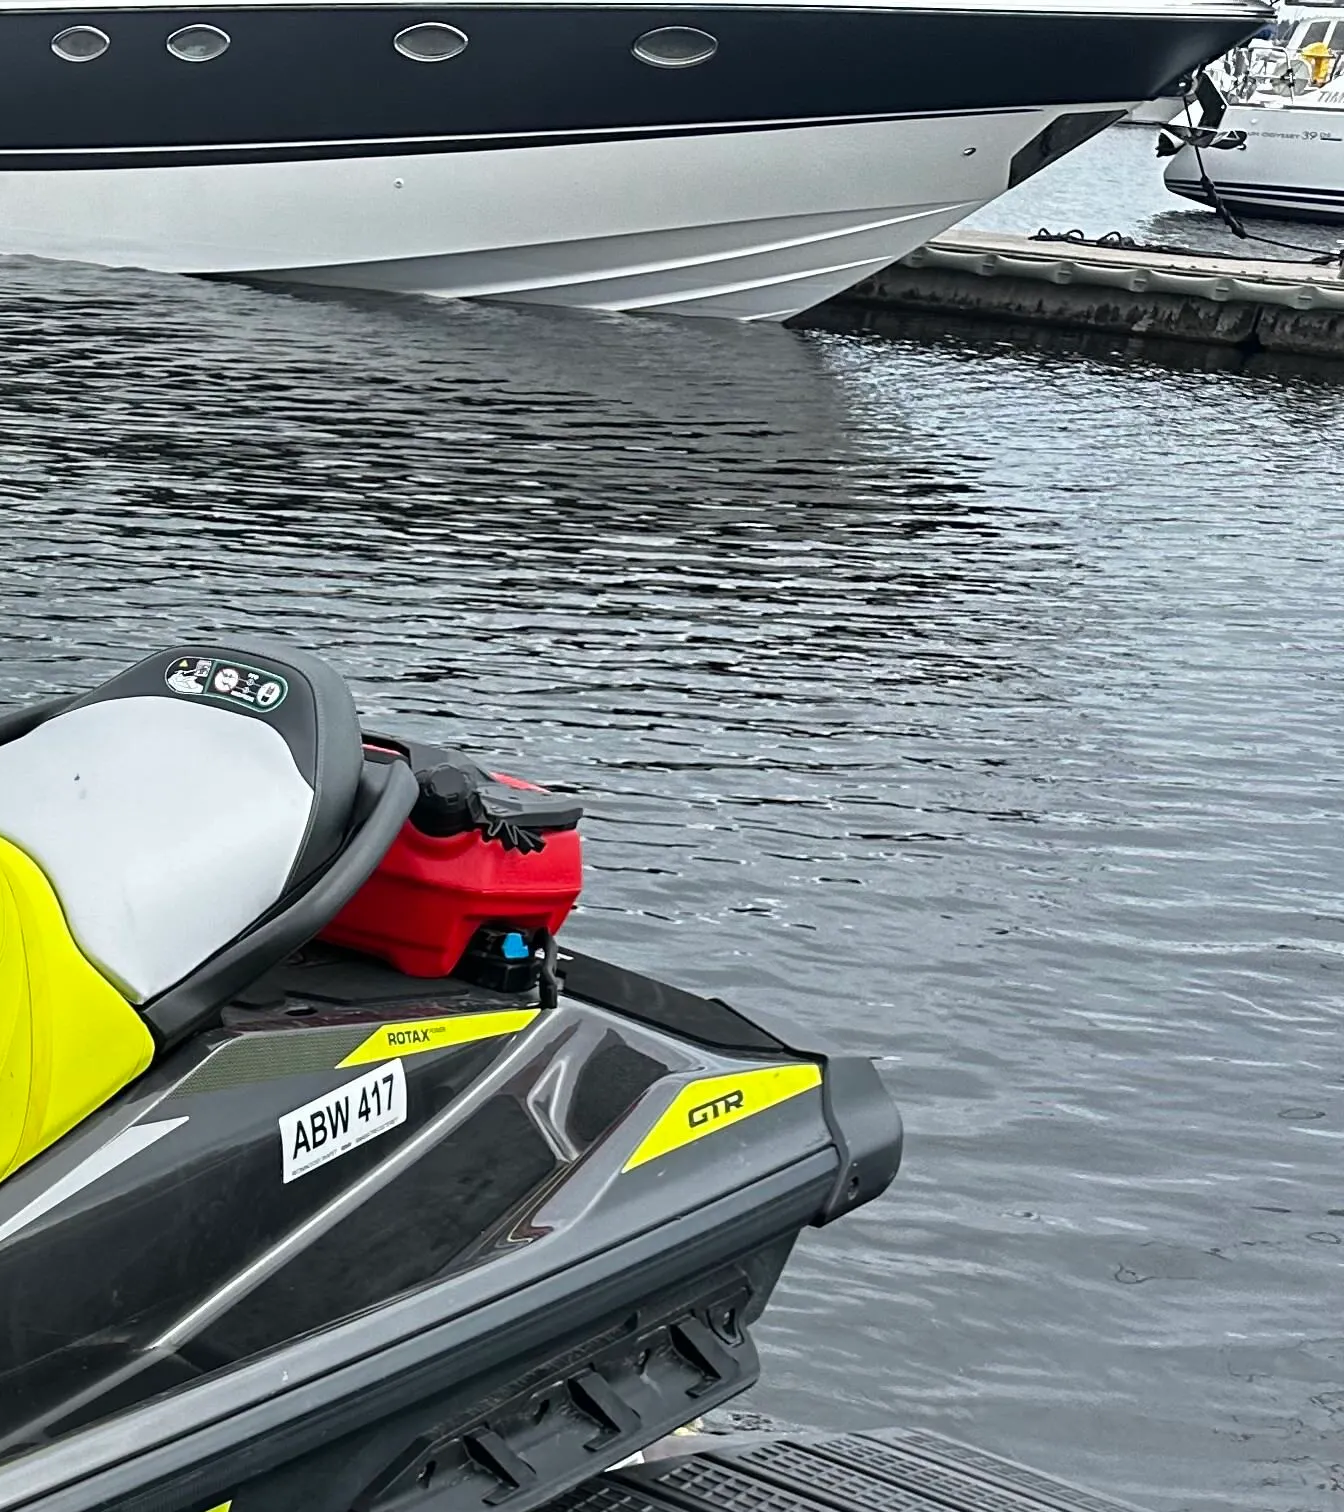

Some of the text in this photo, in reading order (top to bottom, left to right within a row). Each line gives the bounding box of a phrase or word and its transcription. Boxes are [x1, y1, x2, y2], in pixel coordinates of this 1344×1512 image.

[1302, 130, 1318, 140] 39
[387, 1028, 431, 1047] ROTAX
[292, 1096, 350, 1160] ABW
[358, 1074, 395, 1122] 417
[688, 1089, 744, 1129] GTR
